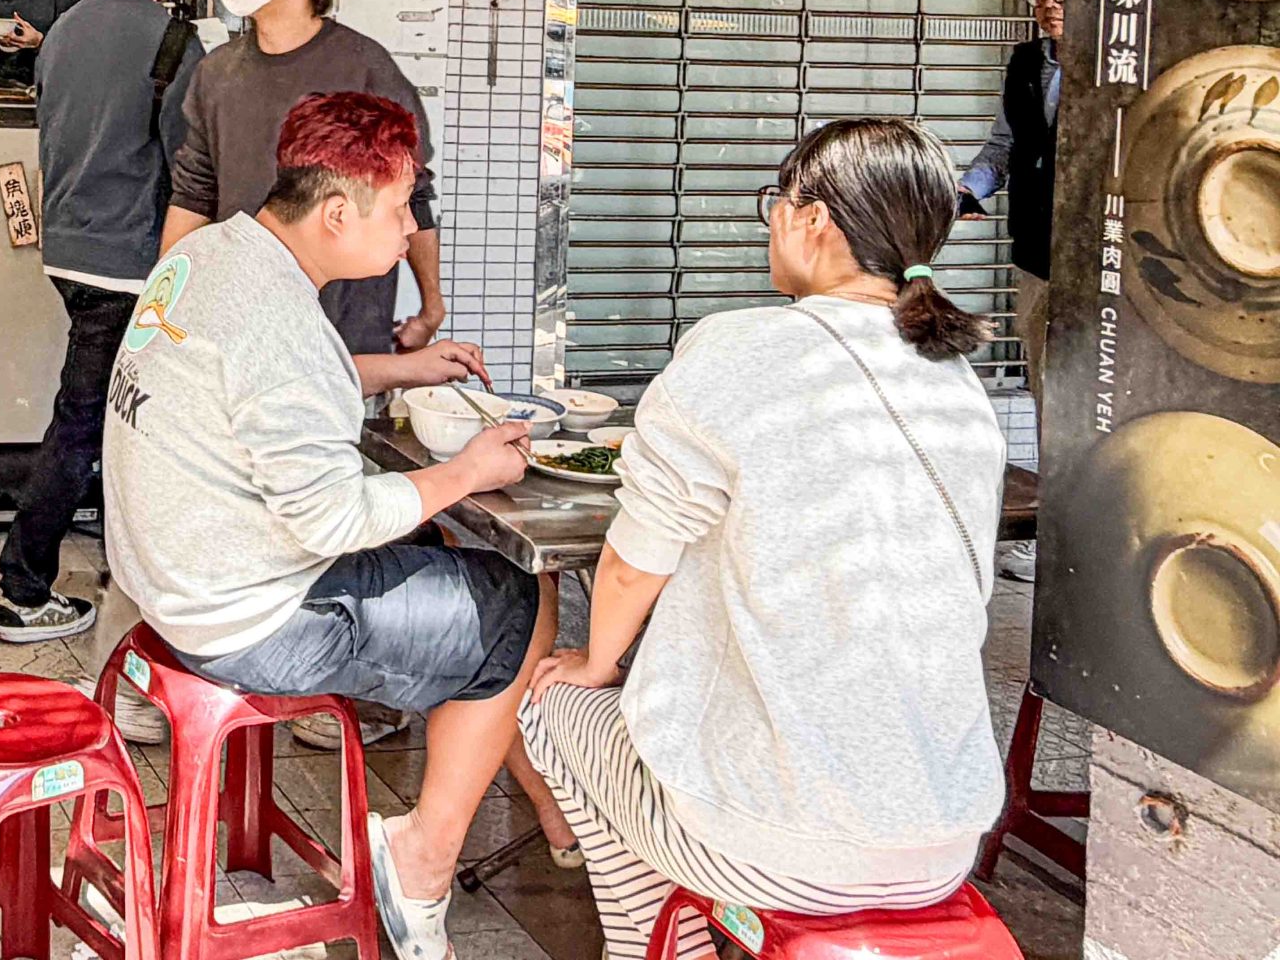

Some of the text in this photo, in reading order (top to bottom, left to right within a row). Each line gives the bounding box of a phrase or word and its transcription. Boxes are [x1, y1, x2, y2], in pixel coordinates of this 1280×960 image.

[1095, 193, 1125, 434] 川業肉圓 CHUAN YEH
